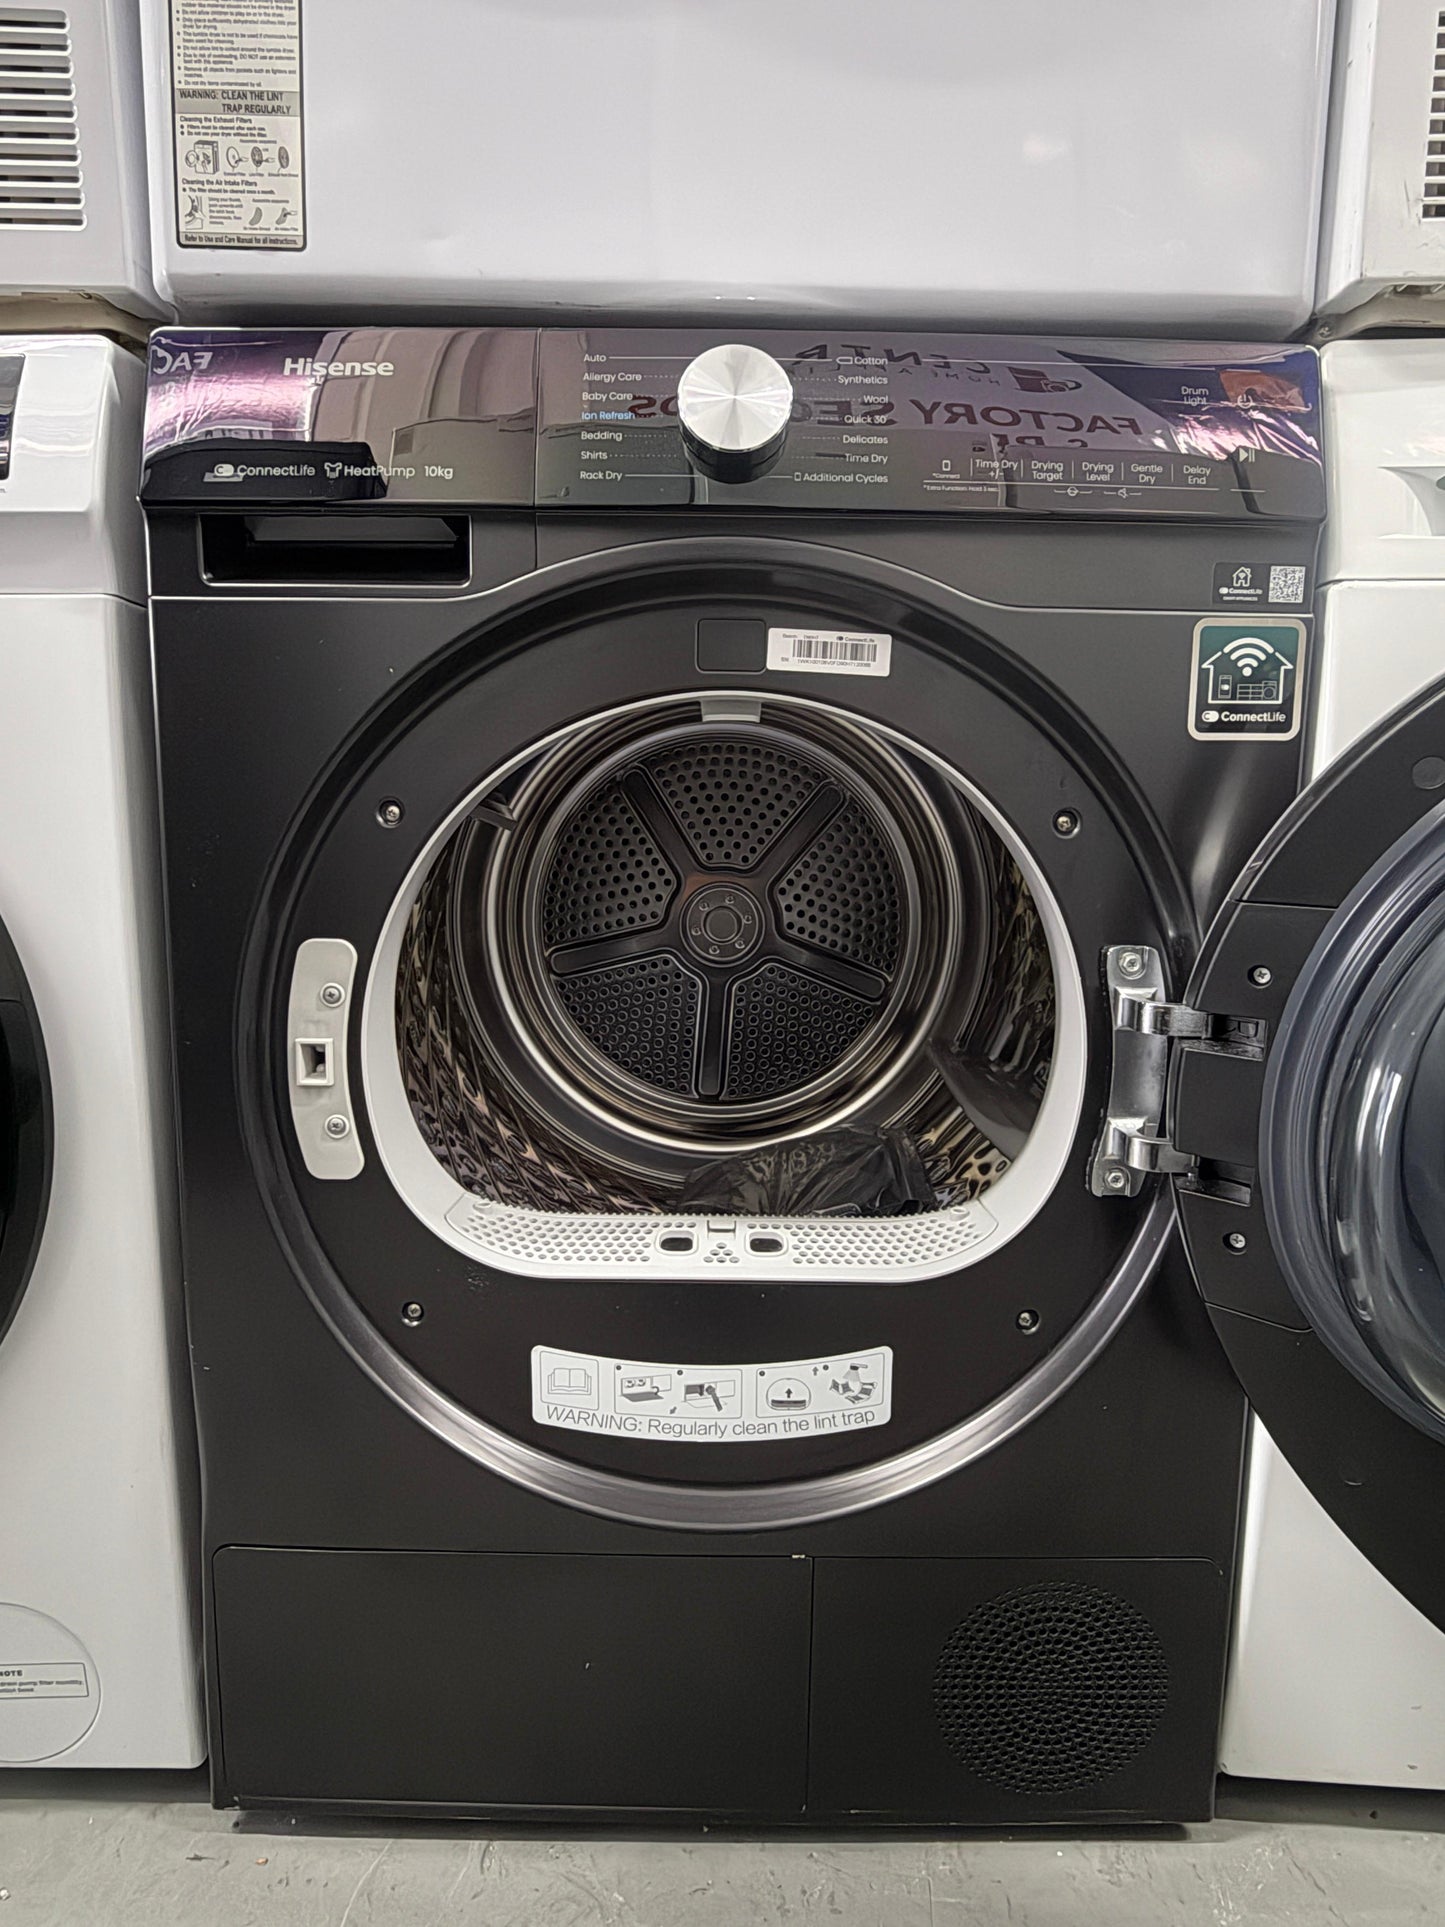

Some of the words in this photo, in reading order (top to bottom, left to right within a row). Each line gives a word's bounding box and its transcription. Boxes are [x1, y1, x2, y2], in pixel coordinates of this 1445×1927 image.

[179, 91, 219, 99] WARNING:
[220, 92, 247, 100] CLEAN
[249, 92, 264, 100] THE
[266, 93, 284, 101] LINT
[222, 104, 242, 113] TRAP
[243, 105, 292, 114] REGULARLY
[180, 116, 202, 124] Cleaning
[182, 179, 204, 187] Cleaning
[583, 354, 607, 362] Auto
[854, 356, 888, 365] Cotton
[283, 358, 394, 377] Hisense
[582, 372, 616, 382] Allergy
[617, 373, 642, 381] Care
[838, 375, 888, 385] Synthetics
[1181, 386, 1209, 395] Drum
[582, 392, 613, 402] Baby
[614, 392, 634, 401] Care
[864, 395, 888, 404] Wool
[1184, 396, 1206, 406] Light
[582, 412, 598, 420] Ion
[599, 412, 635, 420] Refresh
[844, 414, 873, 424] Quick
[581, 431, 623, 442] Bedding
[842, 435, 888, 444] Delicates
[581, 451, 608, 460] Shirts
[845, 453, 869, 462] Time
[870, 454, 888, 465] Dry
[975, 459, 999, 469] Time
[1000, 459, 1018, 471] Dry
[1031, 460, 1064, 472] Drying
[1081, 462, 1114, 473] Drying
[1131, 464, 1163, 473] Gentle
[237, 464, 316, 477] ConnectLife
[344, 465, 416, 479] HeatPump
[424, 465, 453, 480] 10kg
[1032, 470, 1063, 481] Target
[1183, 465, 1211, 476] Delay
[580, 471, 604, 480] Rack
[605, 471, 623, 482] Dry
[803, 473, 854, 482] Additional
[855, 473, 888, 484] Cycles
[1086, 472, 1110, 481] Level
[1139, 474, 1156, 485] Dry
[1188, 475, 1206, 485] End
[1221, 711, 1286, 723] ConnectLife
[547, 1405, 642, 1432] WARNING:
[648, 1418, 728, 1438] Regularly
[732, 1416, 778, 1436] clean
[782, 1414, 809, 1433] the
[813, 1411, 839, 1430] lint
[842, 1408, 876, 1429] trap
